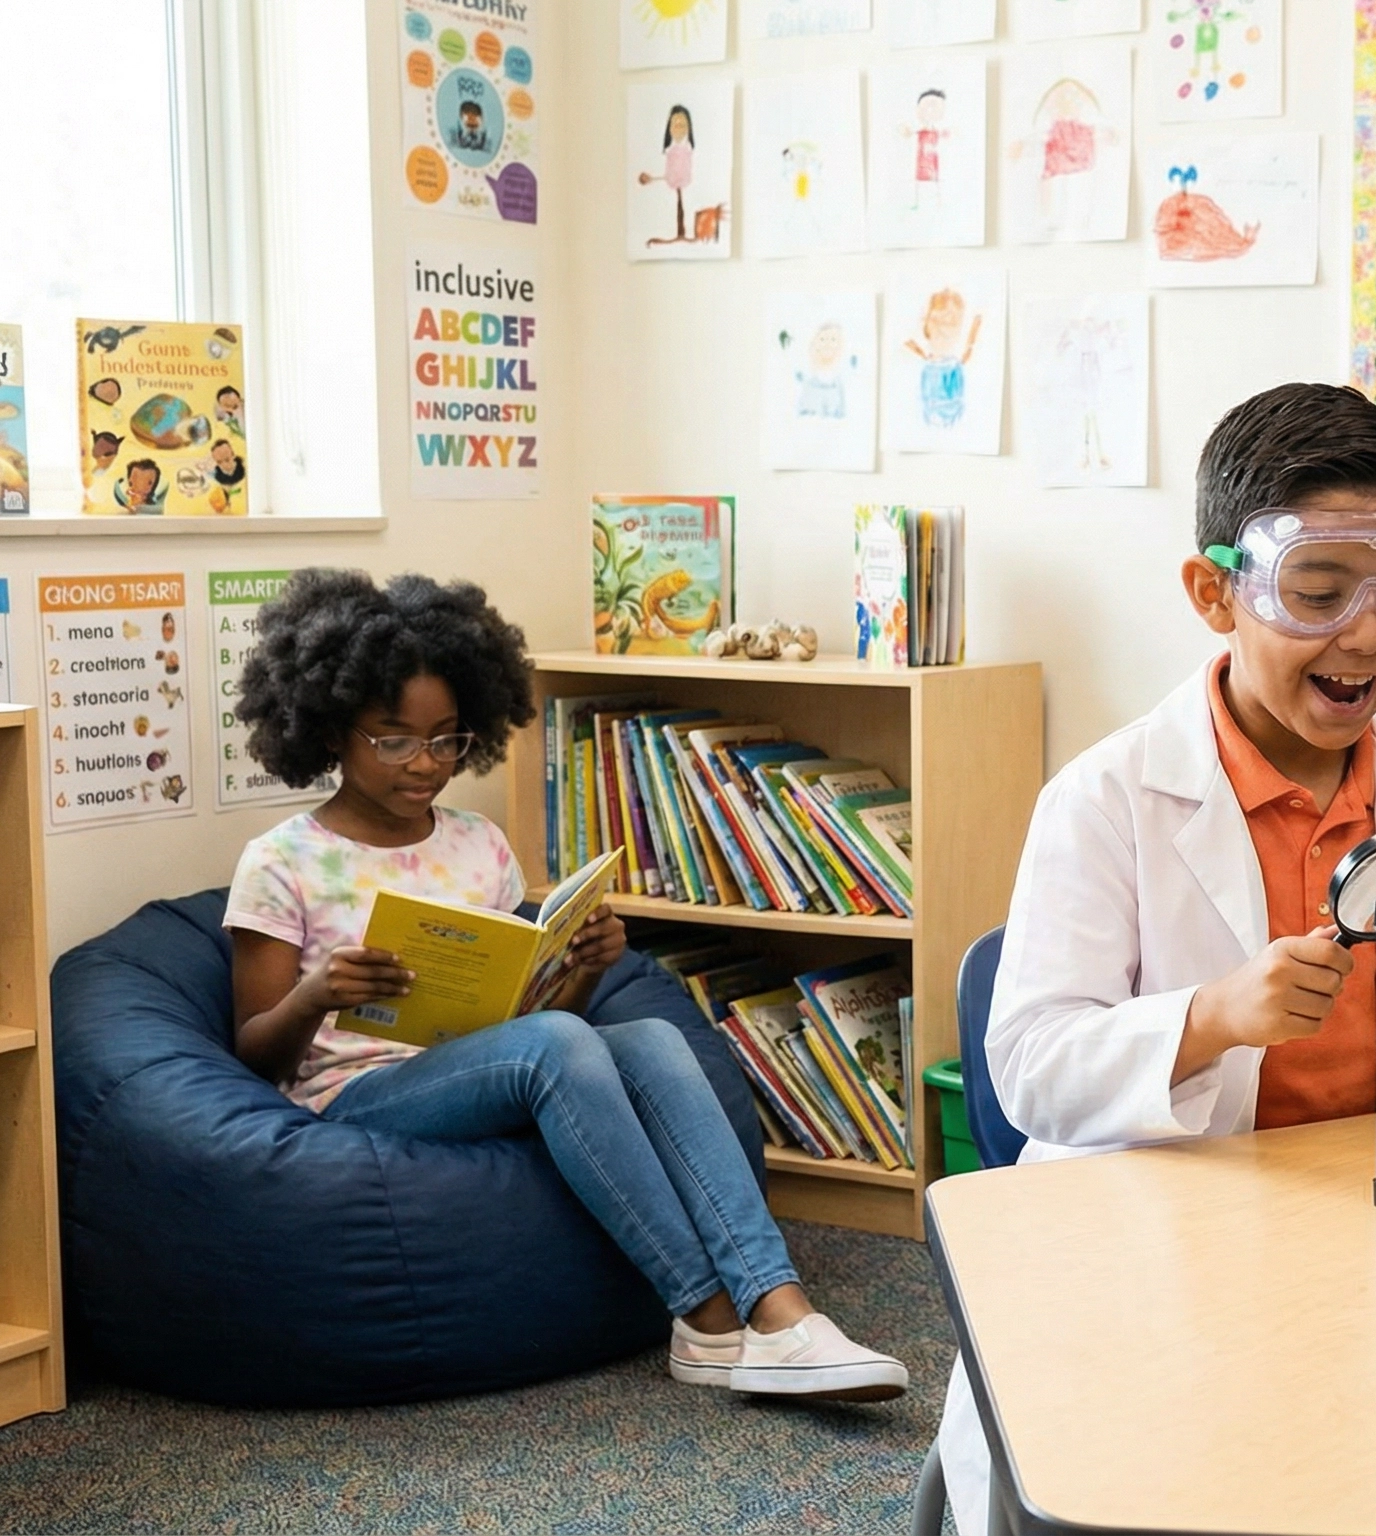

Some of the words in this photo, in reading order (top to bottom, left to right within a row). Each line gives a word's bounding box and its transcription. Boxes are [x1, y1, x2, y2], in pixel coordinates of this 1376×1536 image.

[415, 260, 534, 301] inclusive
[414, 307, 536, 347] ABCDEF
[416, 352, 537, 391] GHIJKL
[416, 401, 536, 423] NNOPQRSTU
[49, 658, 65, 675] 2.
[51, 691, 67, 708] 3.
[53, 725, 69, 741] 4.
[54, 758, 70, 775] 5.
